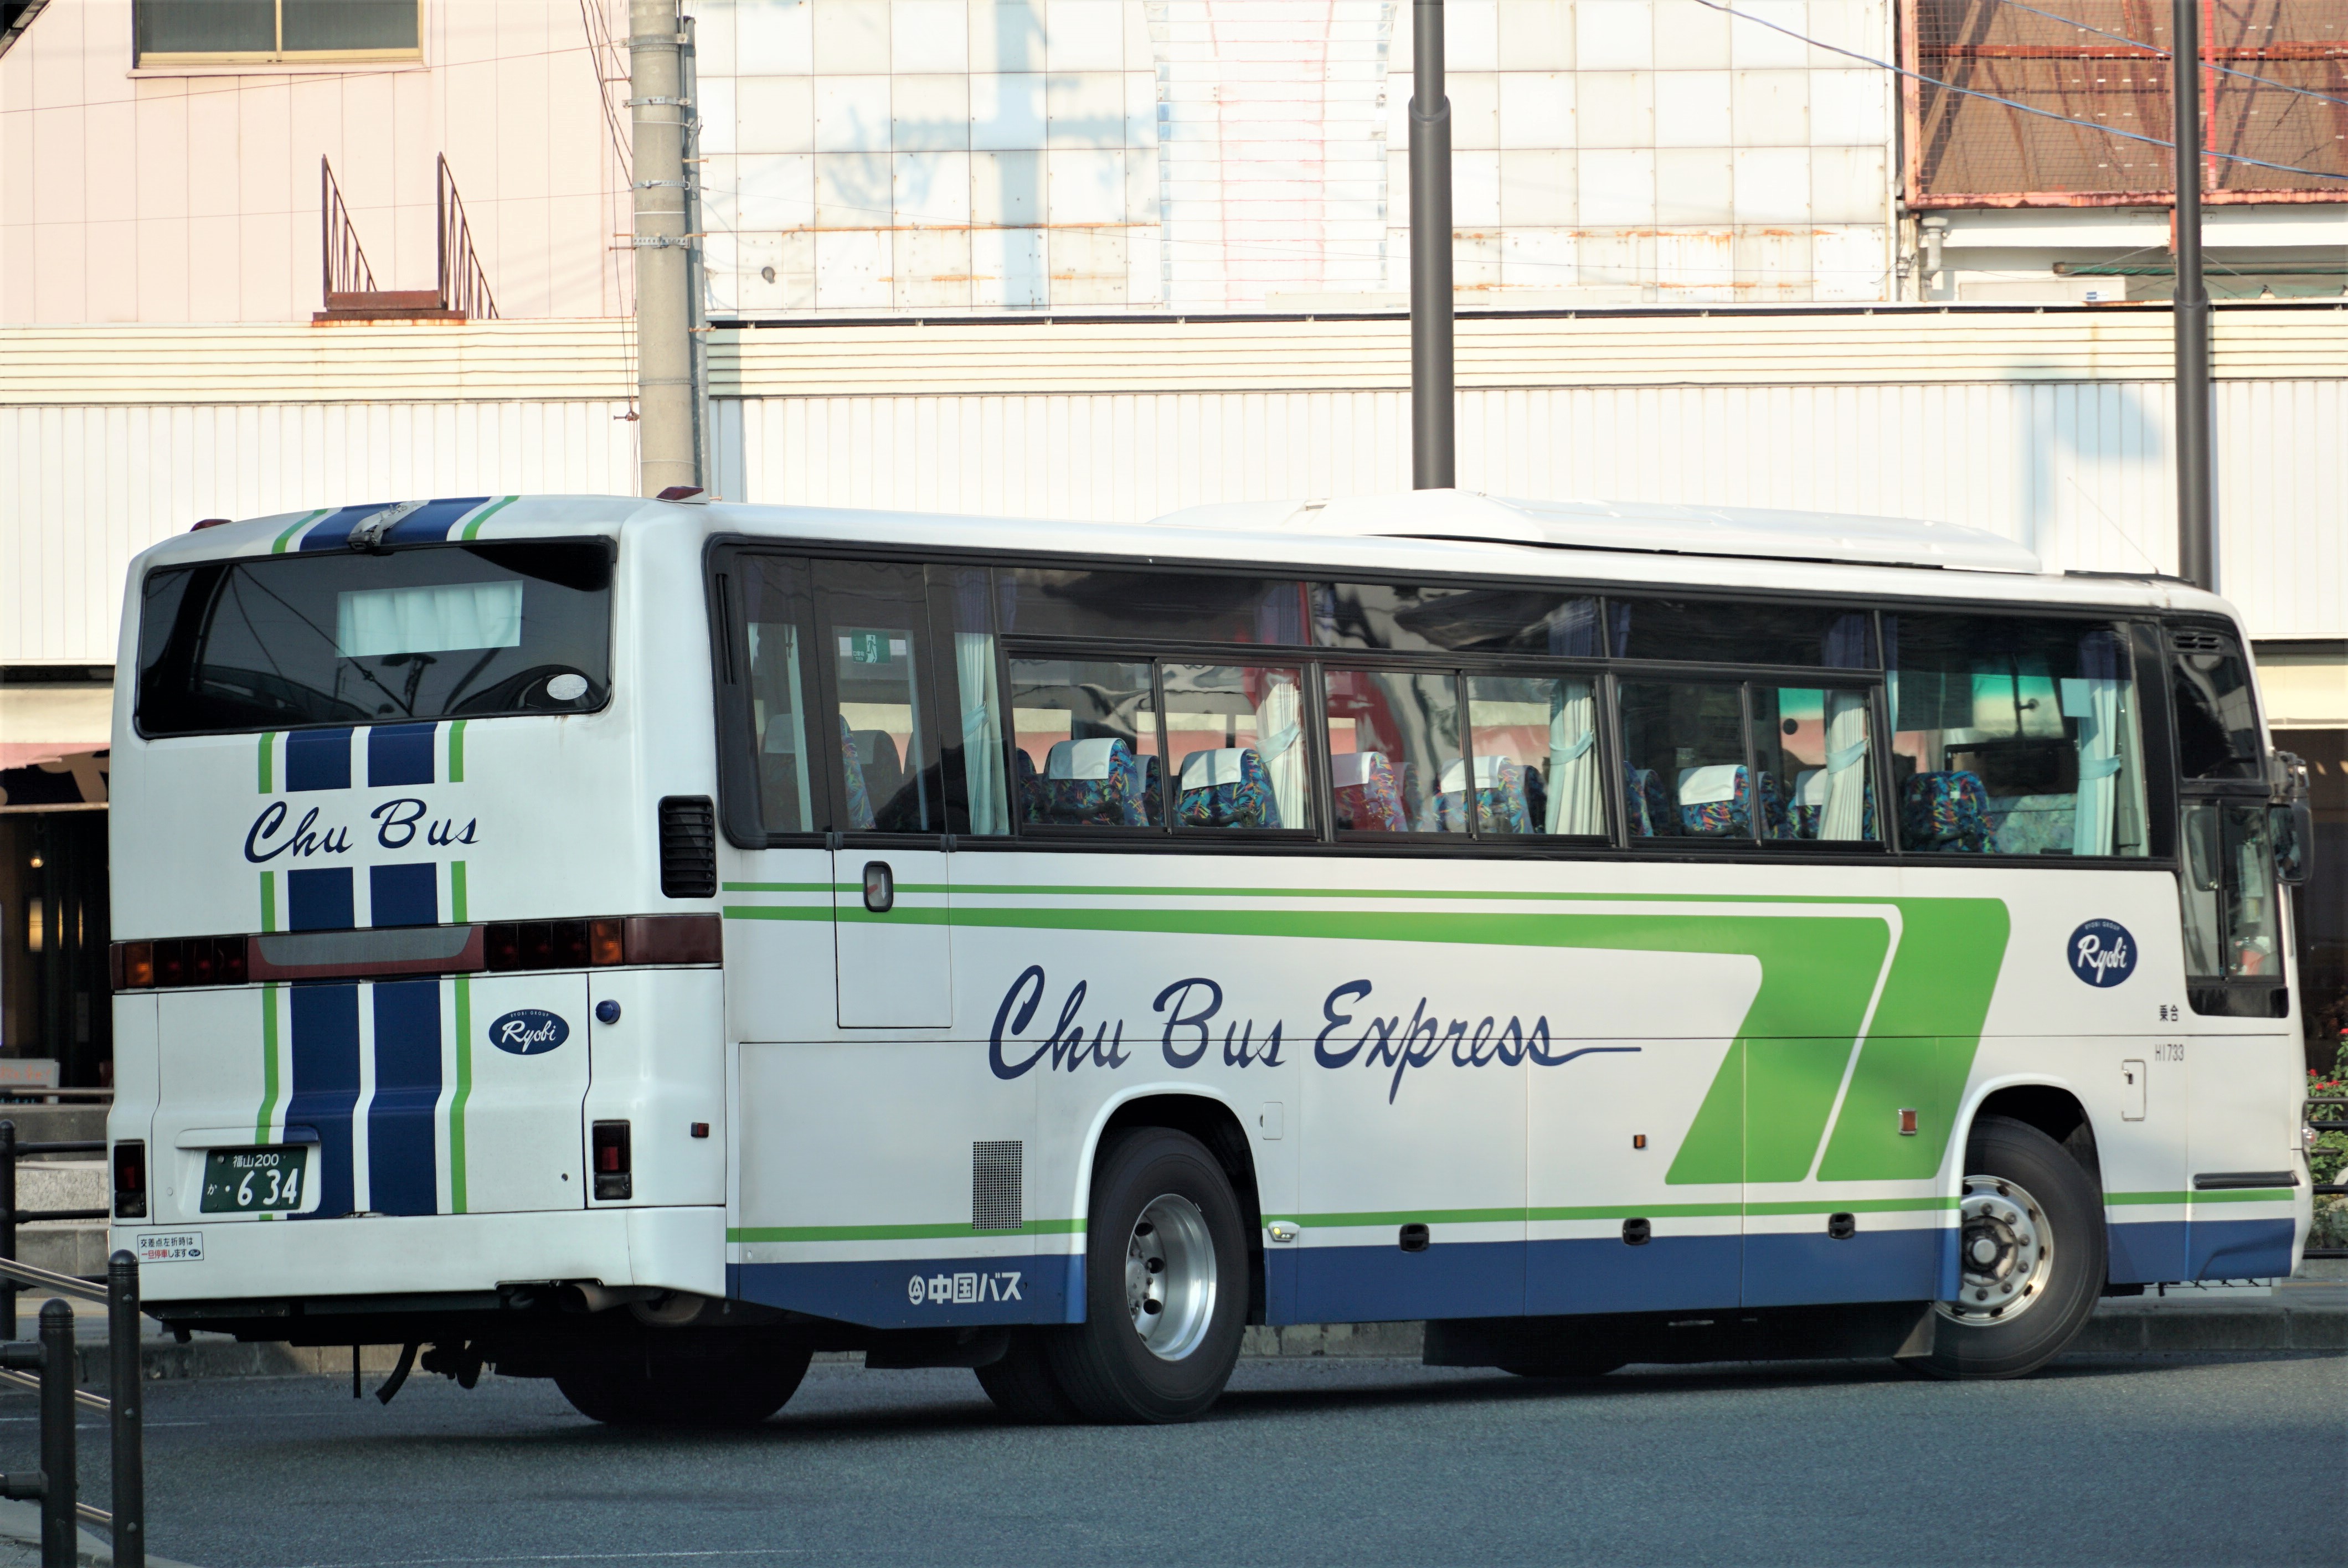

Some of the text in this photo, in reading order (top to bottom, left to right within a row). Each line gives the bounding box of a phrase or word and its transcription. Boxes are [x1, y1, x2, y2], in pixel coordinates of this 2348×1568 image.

[244, 798, 480, 863] Chu Bus
[2077, 934, 2127, 984] Ryobi
[502, 1020, 556, 1053] Ryobi
[988, 964, 1641, 1105] Chu Bus Express
[141, 1236, 193, 1249] 交差点左折時は
[928, 1271, 1022, 1304] 中国バス
